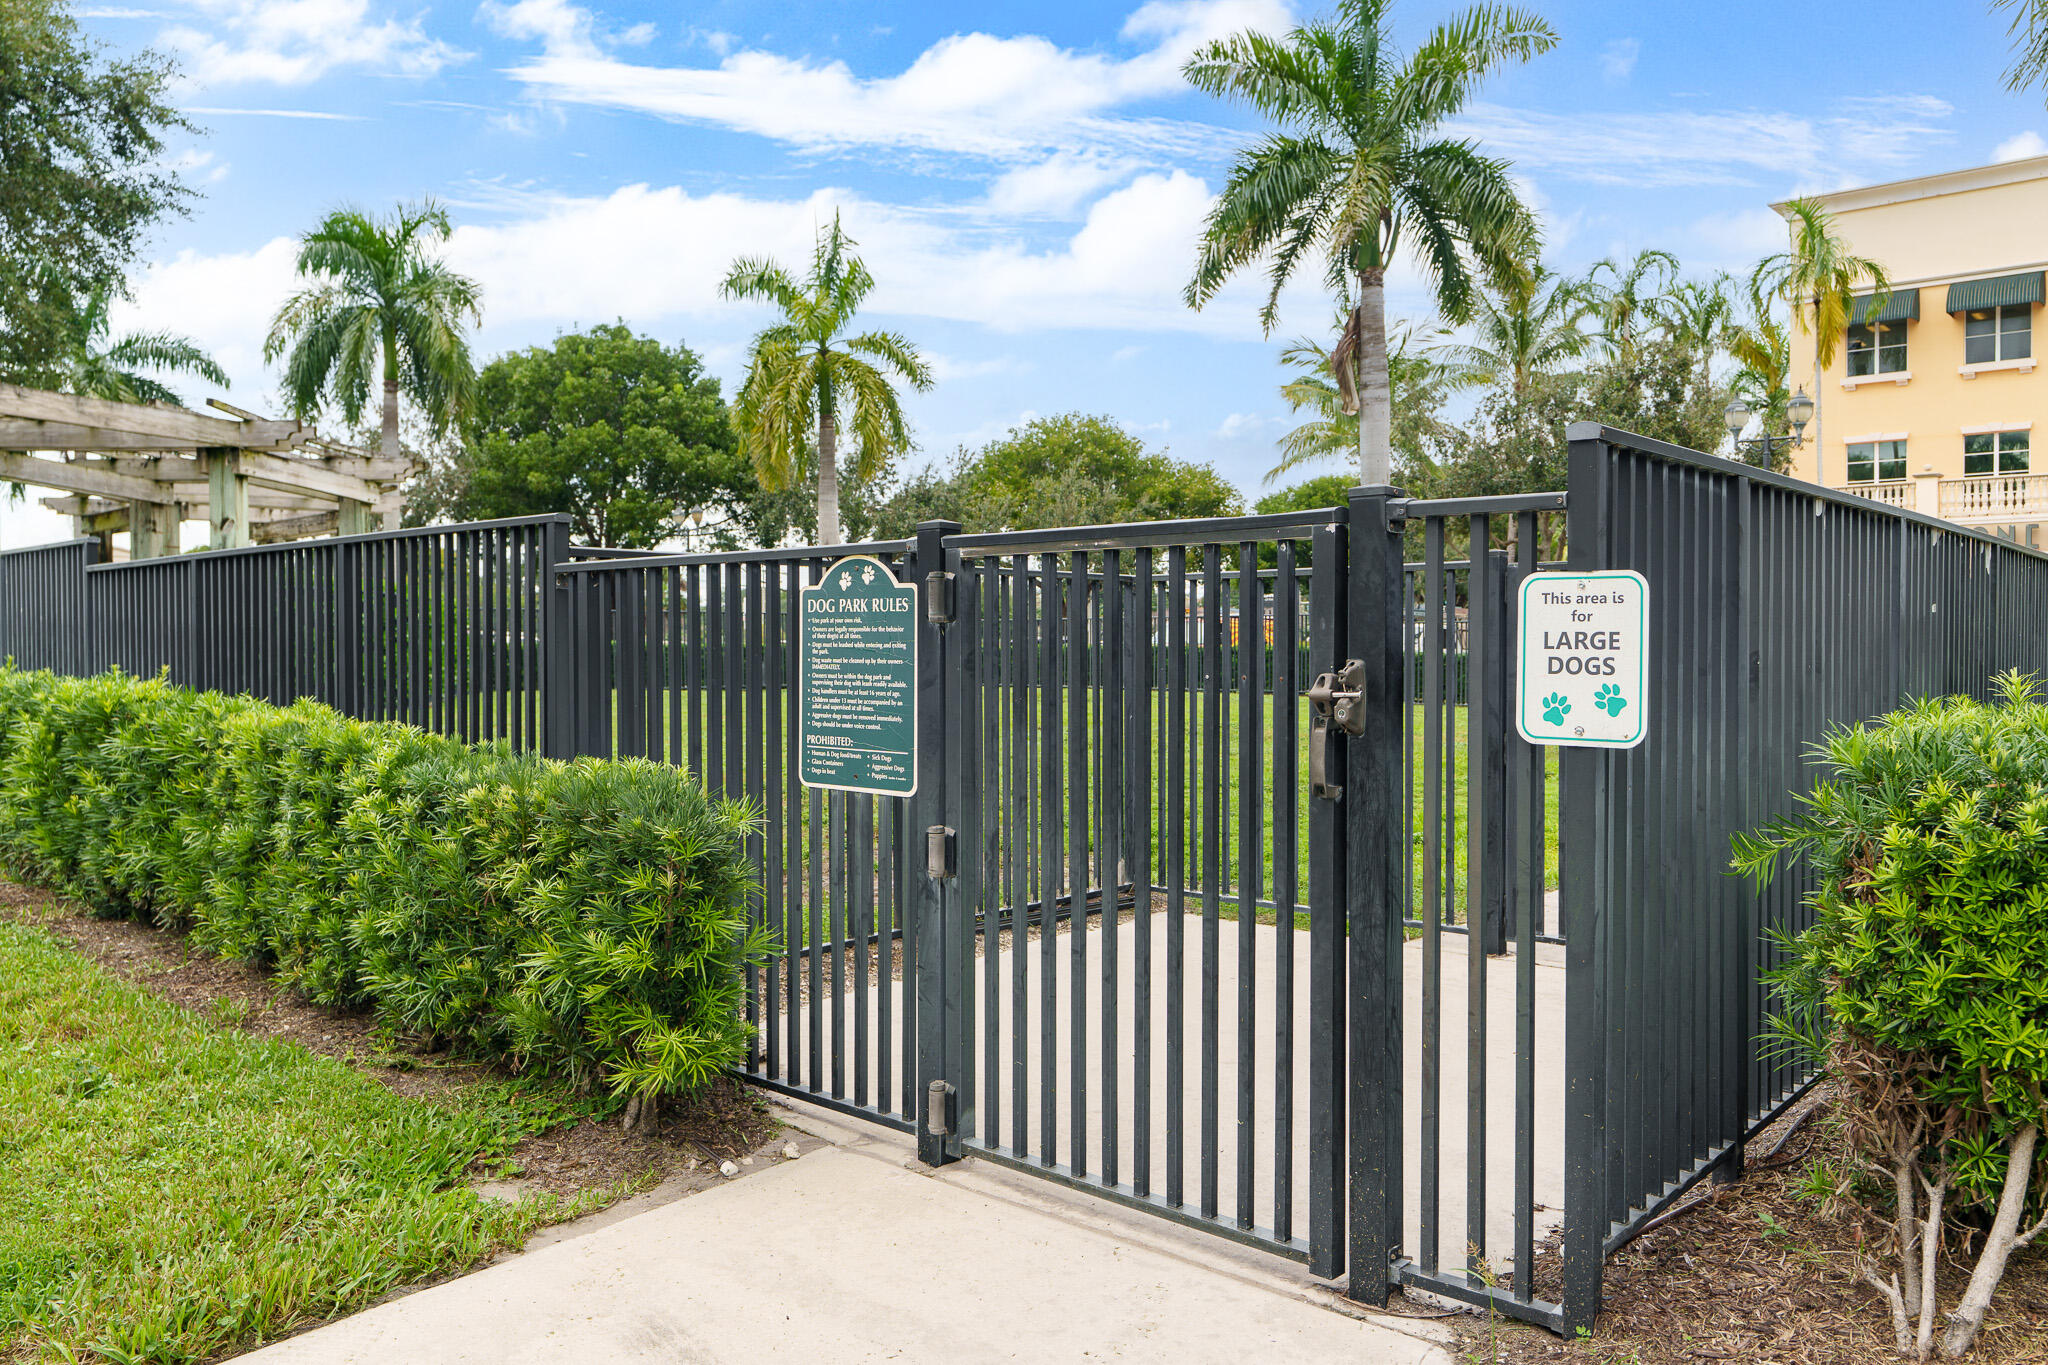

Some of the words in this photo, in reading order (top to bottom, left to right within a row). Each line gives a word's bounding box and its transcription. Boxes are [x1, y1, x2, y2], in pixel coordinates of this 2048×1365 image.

[1542, 592, 1571, 604] This
[1576, 593, 1607, 604] area
[1613, 592, 1624, 603] is
[808, 599, 835, 613] DOG
[840, 599, 868, 612] PARK
[872, 598, 908, 612] RULES
[1571, 610, 1592, 622] for
[892, 642, 906, 650] exiting
[1544, 632, 1621, 650] LARGE
[1548, 656, 1616, 675] DOGS
[807, 735, 853, 746] PROHIBITED:
[881, 755, 892, 763] Dogs
[811, 767, 821, 775] Dogs
